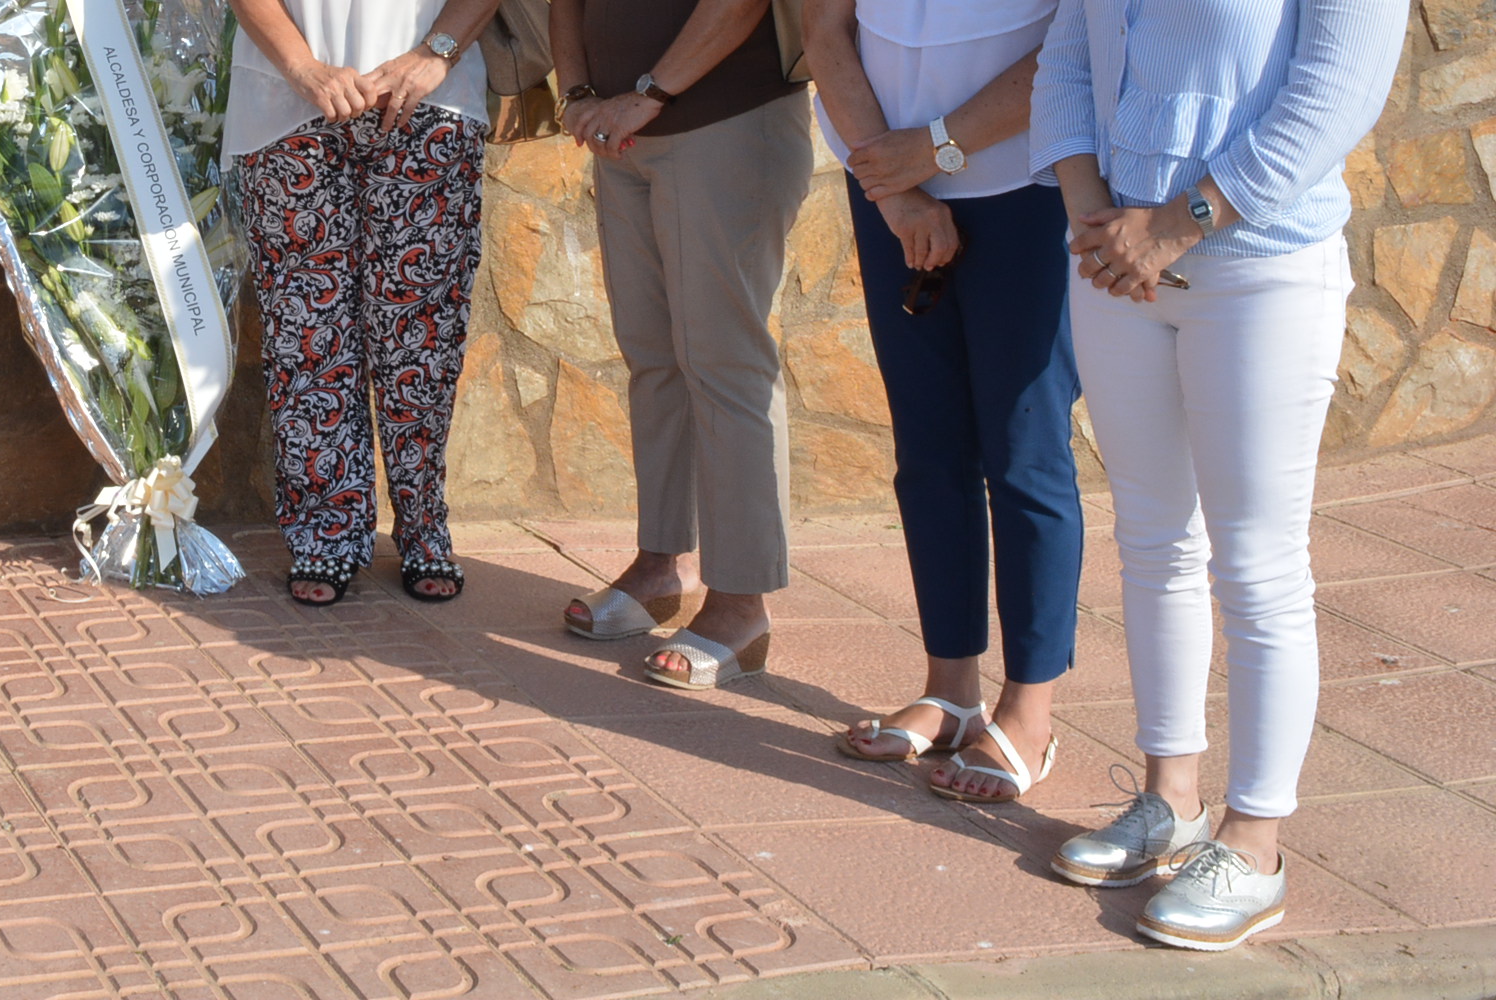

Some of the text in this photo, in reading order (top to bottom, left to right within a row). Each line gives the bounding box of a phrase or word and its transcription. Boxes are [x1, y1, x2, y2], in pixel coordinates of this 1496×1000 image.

[104, 46, 140, 127] ALCALDESA
[133, 128, 146, 138] Y
[172, 254, 206, 336] MUNICIPAL
